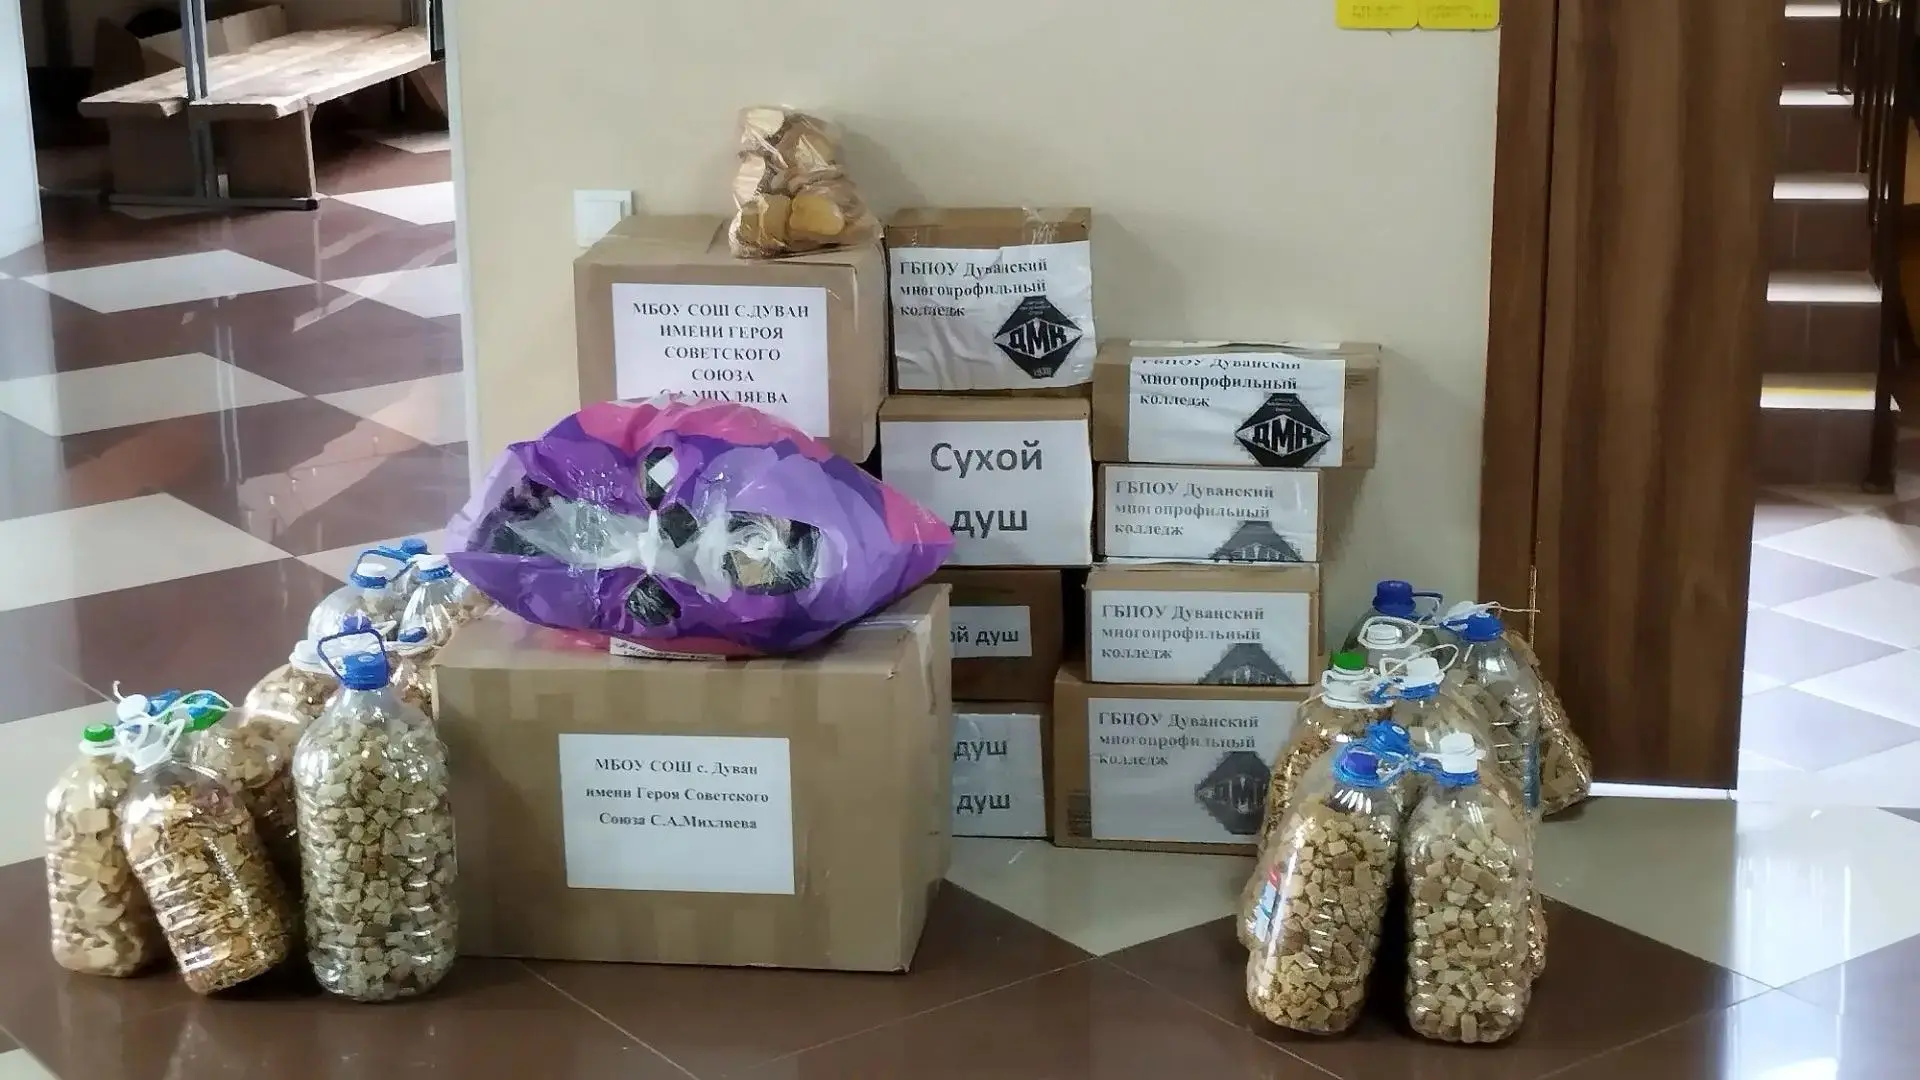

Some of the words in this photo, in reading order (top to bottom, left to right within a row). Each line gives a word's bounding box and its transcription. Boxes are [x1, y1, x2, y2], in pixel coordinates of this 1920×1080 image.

[900, 262, 959, 277] ГБПОУ
[963, 258, 1047, 279] Дуванский
[900, 281, 1046, 300] многопрофильный
[633, 302, 682, 317] МБОУ
[687, 303, 730, 318] СОШ
[660, 324, 724, 339] ИМЕНИ
[729, 326, 783, 340] ГЕРОЯ
[664, 346, 781, 362] СОВЕТСКОГО
[691, 368, 754, 383] СОЮЗА
[1140, 374, 1297, 391] многопрофильный
[660, 388, 788, 404] МИХЛЯЕВА
[1140, 395, 1210, 408] колледж
[930, 440, 1043, 479] Сухой
[1115, 480, 1179, 496] ГБПОУ
[1183, 483, 1274, 499] Дуванский
[1115, 503, 1270, 520] многопрофильный
[951, 510, 1028, 539] душ
[1114, 524, 1184, 537] колледж
[1102, 605, 1167, 619] ГБПОУ
[1171, 606, 1265, 622] Дуванский
[975, 630, 1019, 646] душ
[1102, 627, 1261, 643] многопрофильный
[1101, 648, 1173, 661] колледж
[1099, 712, 1163, 726] ГБПОУ
[1167, 713, 1259, 730] Дуванский
[953, 740, 1007, 761] душ
[595, 759, 643, 772] МБОУ
[650, 760, 692, 773] СОШ
[711, 762, 758, 776] Дуван
[585, 787, 632, 798] имени
[636, 787, 680, 802] Героя
[684, 788, 770, 803] Советского
[956, 794, 1010, 814] душ
[599, 812, 646, 826] Союза
